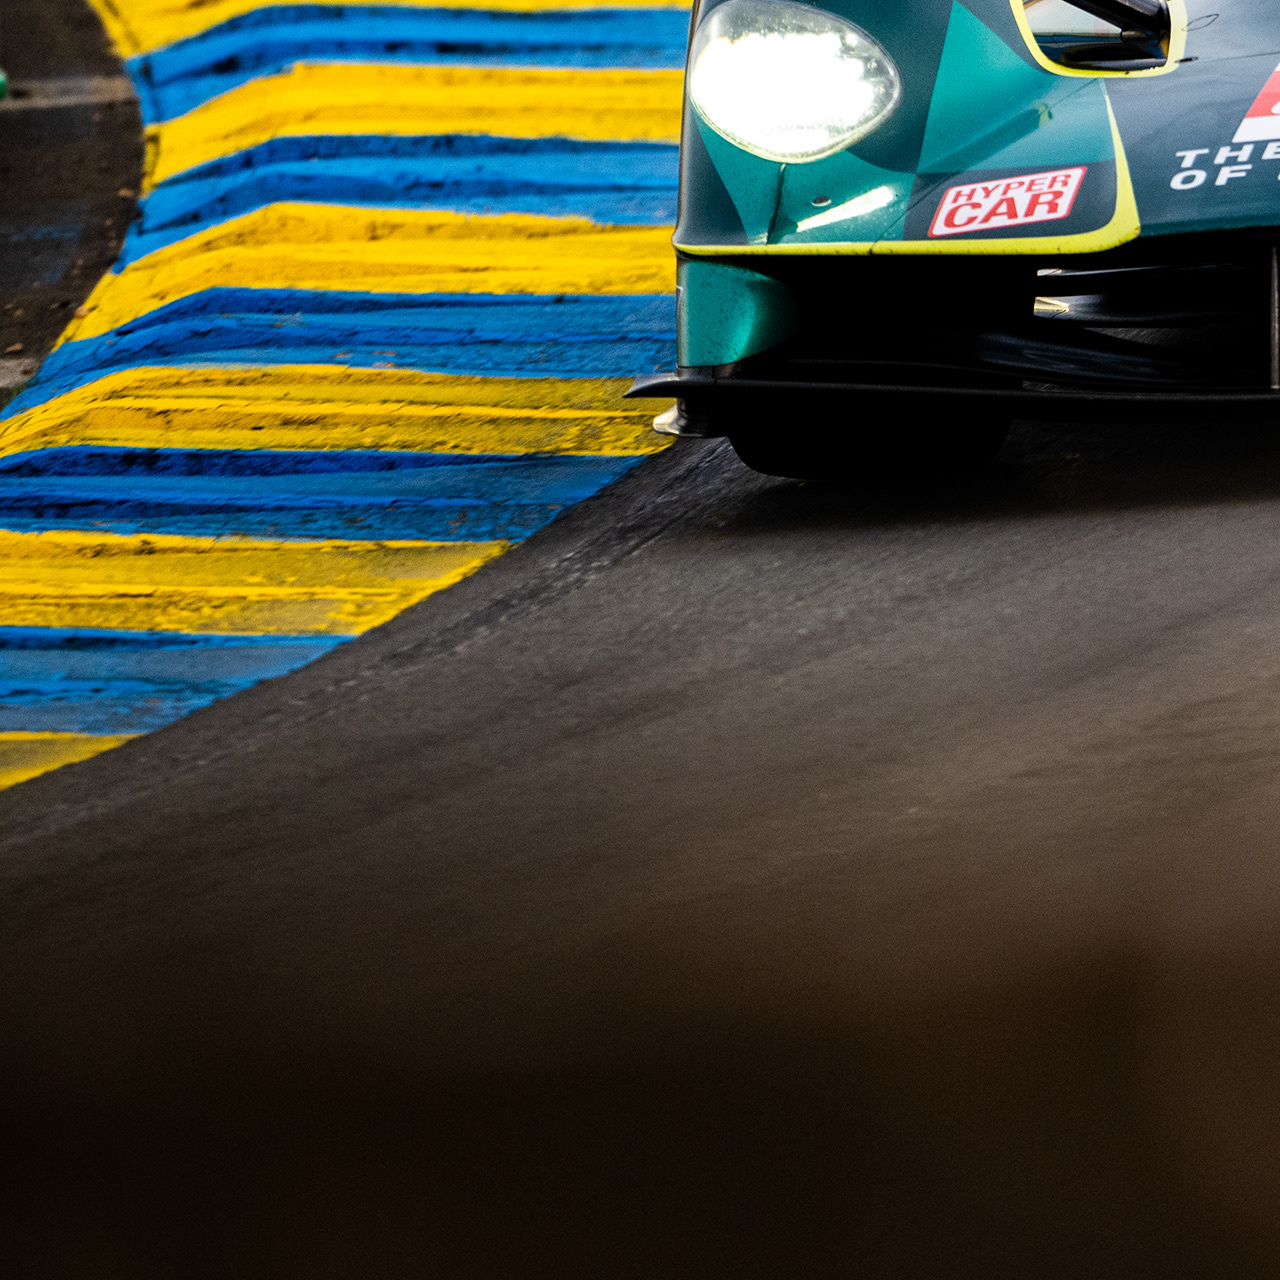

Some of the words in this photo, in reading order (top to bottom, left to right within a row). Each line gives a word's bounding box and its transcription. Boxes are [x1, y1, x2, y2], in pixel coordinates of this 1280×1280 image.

[951, 174, 1072, 204] HYPER
[1170, 163, 1253, 191] OF
[943, 190, 1064, 229] CAR
